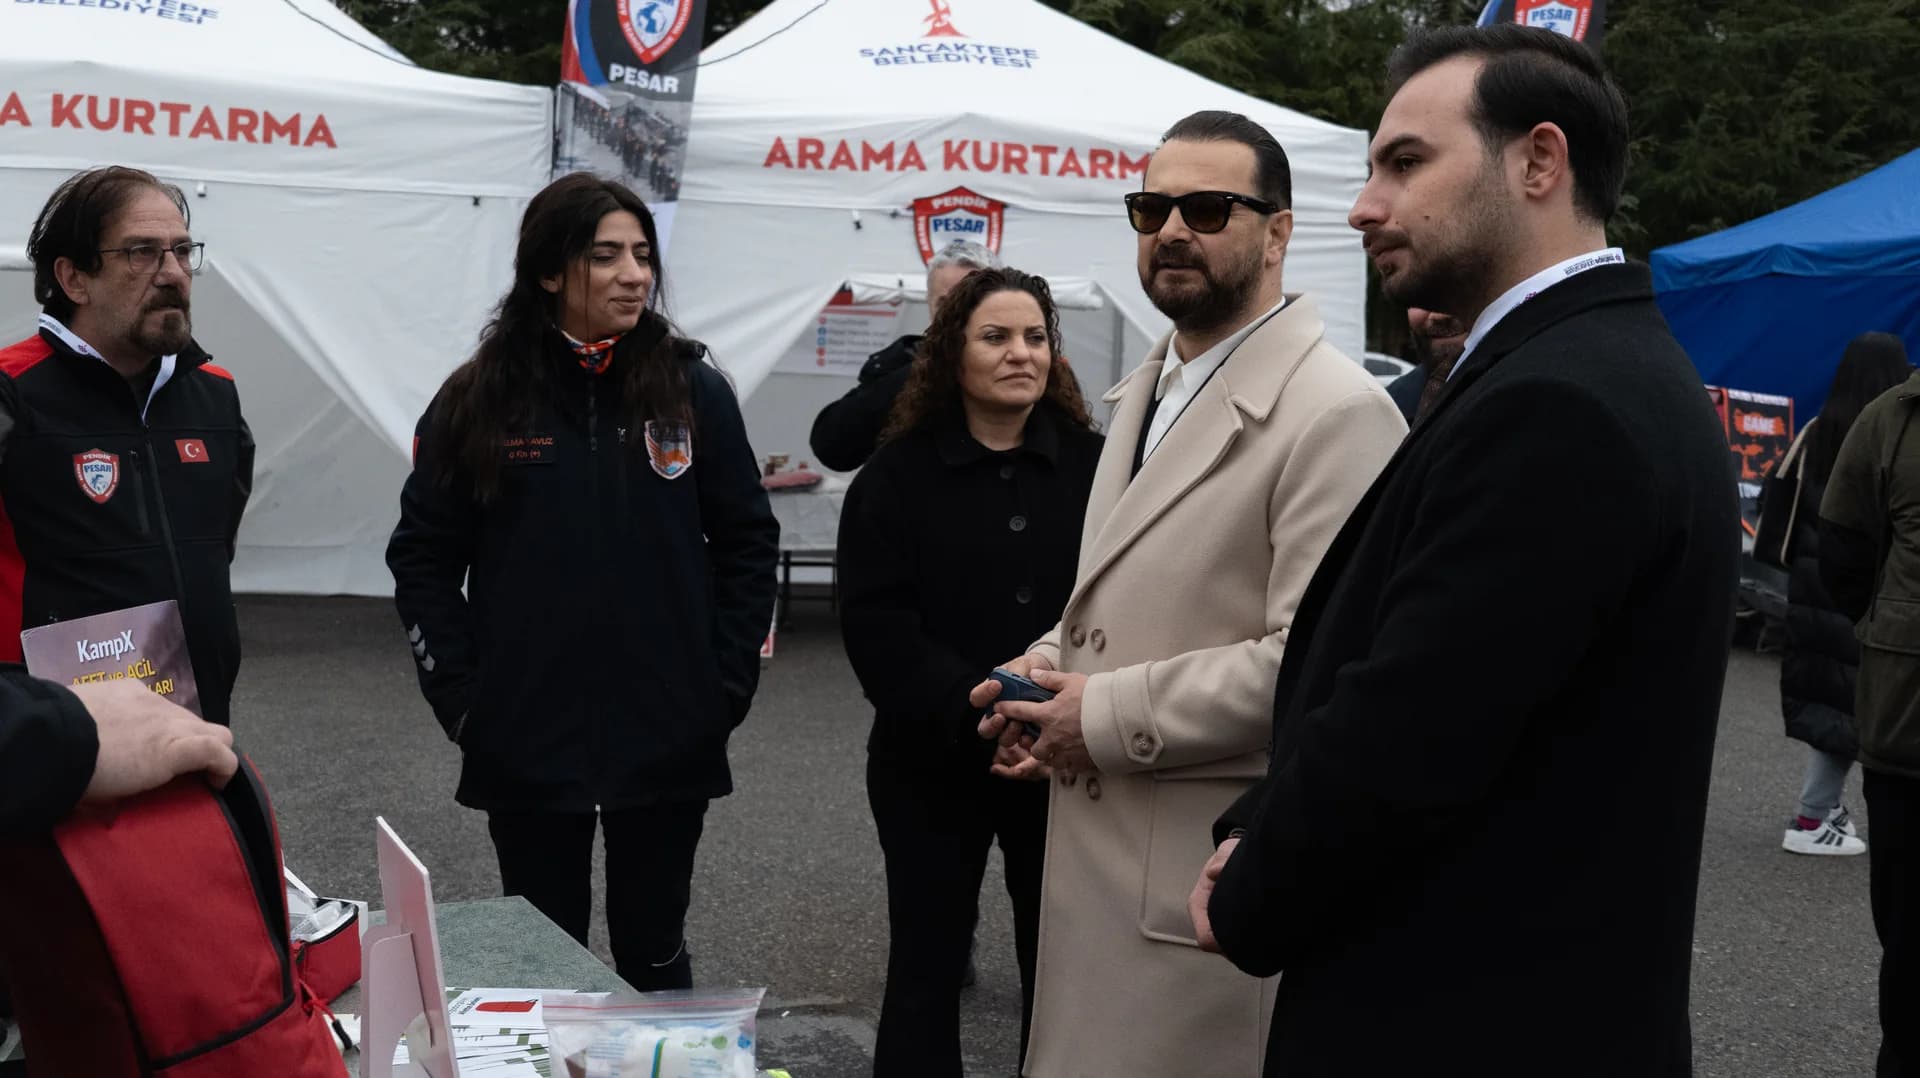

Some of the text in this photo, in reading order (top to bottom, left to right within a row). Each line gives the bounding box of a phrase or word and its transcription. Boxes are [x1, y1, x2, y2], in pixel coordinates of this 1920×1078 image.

[14, 0, 203, 24] LEDİYESİ
[1532, 8, 1573, 21] PESAR
[859, 43, 1040, 60] SANCAKTEPE
[609, 63, 679, 93] PESAR
[52, 93, 337, 148] KURTARMA
[763, 136, 1150, 179] ARAMA KURTARM
[932, 217, 985, 234] PESAR
[84, 464, 112, 473] PESAR
[76, 630, 136, 663] KampX
[127, 658, 156, 679] ACİL
